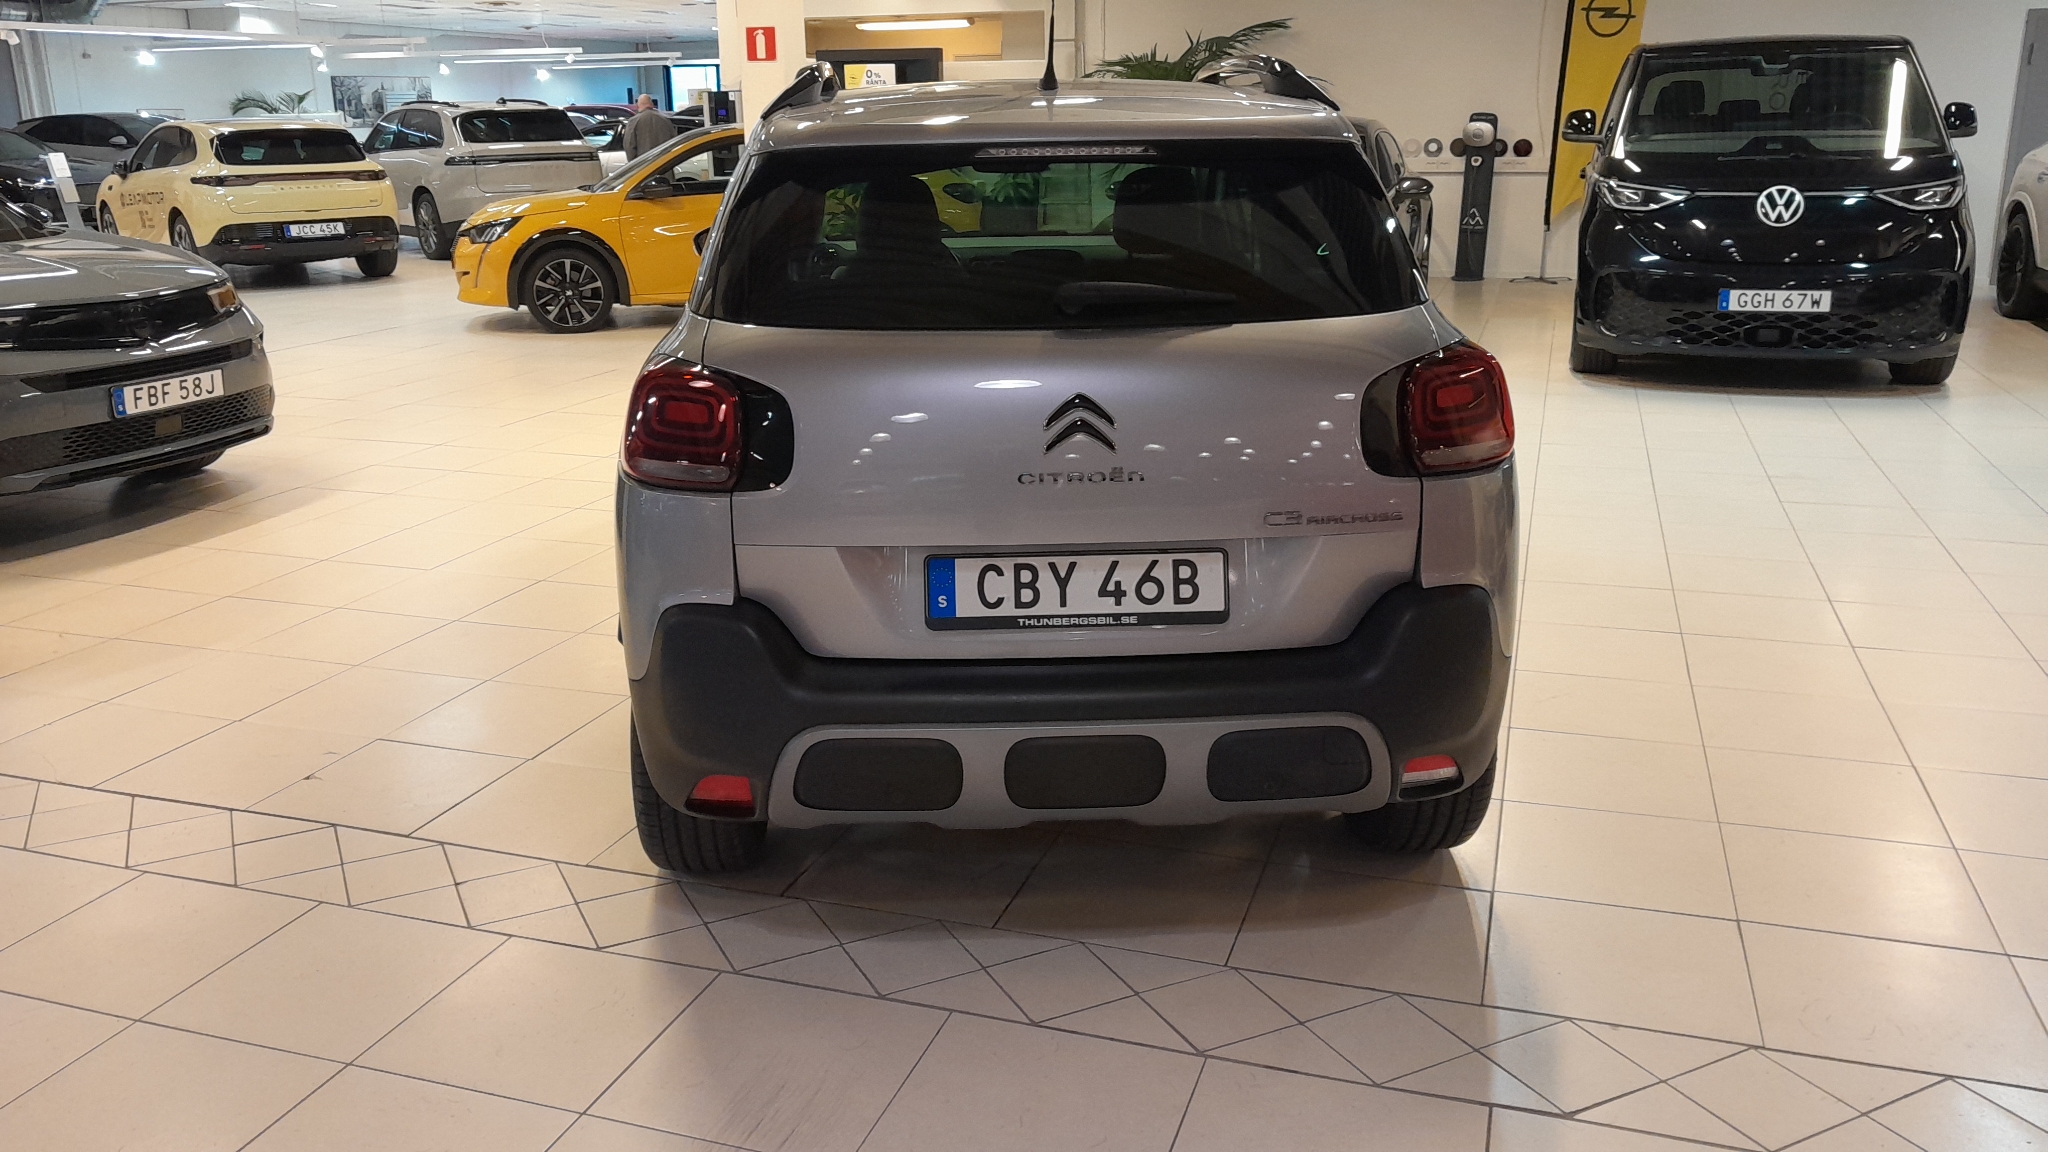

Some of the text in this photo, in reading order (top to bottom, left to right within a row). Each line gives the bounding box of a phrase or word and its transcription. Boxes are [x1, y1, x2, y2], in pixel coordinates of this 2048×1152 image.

[865, 69, 873, 79] 0
[296, 224, 316, 235] JCC
[319, 223, 340, 233] 45K
[1737, 292, 1823, 310] GGH 67W
[133, 373, 215, 410] FBF 58J
[1263, 510, 1404, 527] C3 AIRCROSS
[976, 558, 1201, 610] CBY 46B
[937, 596, 948, 608] S
[1017, 615, 1139, 627] THUNBERGSBIL.SE
